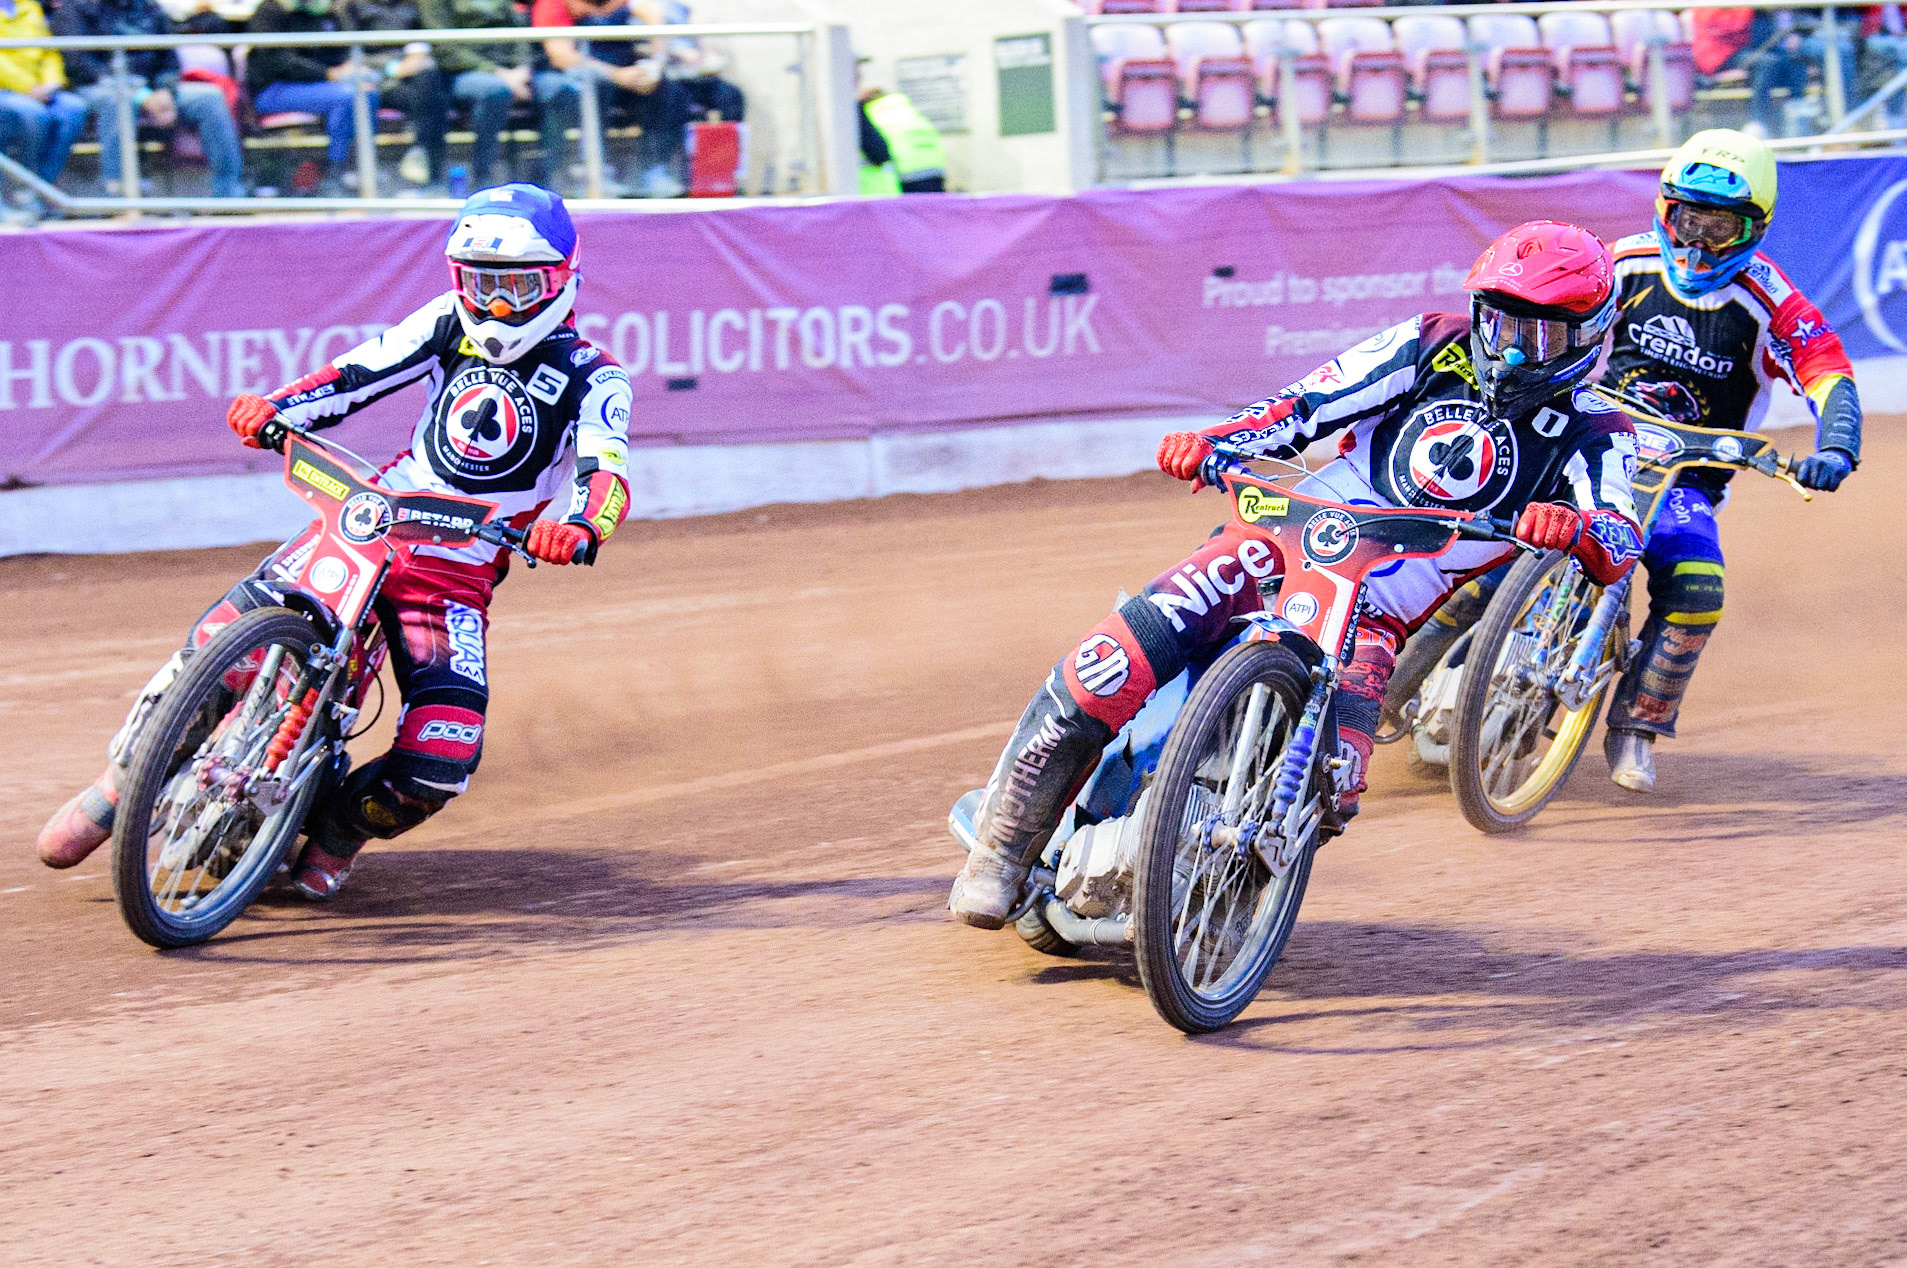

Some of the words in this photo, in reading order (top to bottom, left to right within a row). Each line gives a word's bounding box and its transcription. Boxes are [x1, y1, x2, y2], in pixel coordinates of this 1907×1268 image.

[1204, 271, 1283, 307] Proud
[1287, 273, 1318, 304] to
[1321, 270, 1427, 307] sponsor
[575, 295, 1103, 377] SOLICITORS.CO.UK
[1628, 322, 1734, 373] Crendon
[450, 370, 486, 398] BELLE
[489, 372, 515, 393] VUE
[514, 396, 533, 434] ACES
[533, 371, 562, 396] 5
[1424, 405, 1473, 426] BELLE
[1494, 434, 1509, 477] ACES
[1243, 494, 1286, 515] Rentruck
[1307, 511, 1328, 530] BELLE
[1147, 539, 1275, 633] Nice
[1288, 603, 1312, 614] ATPI
[989, 712, 1067, 842] INOTHERM
